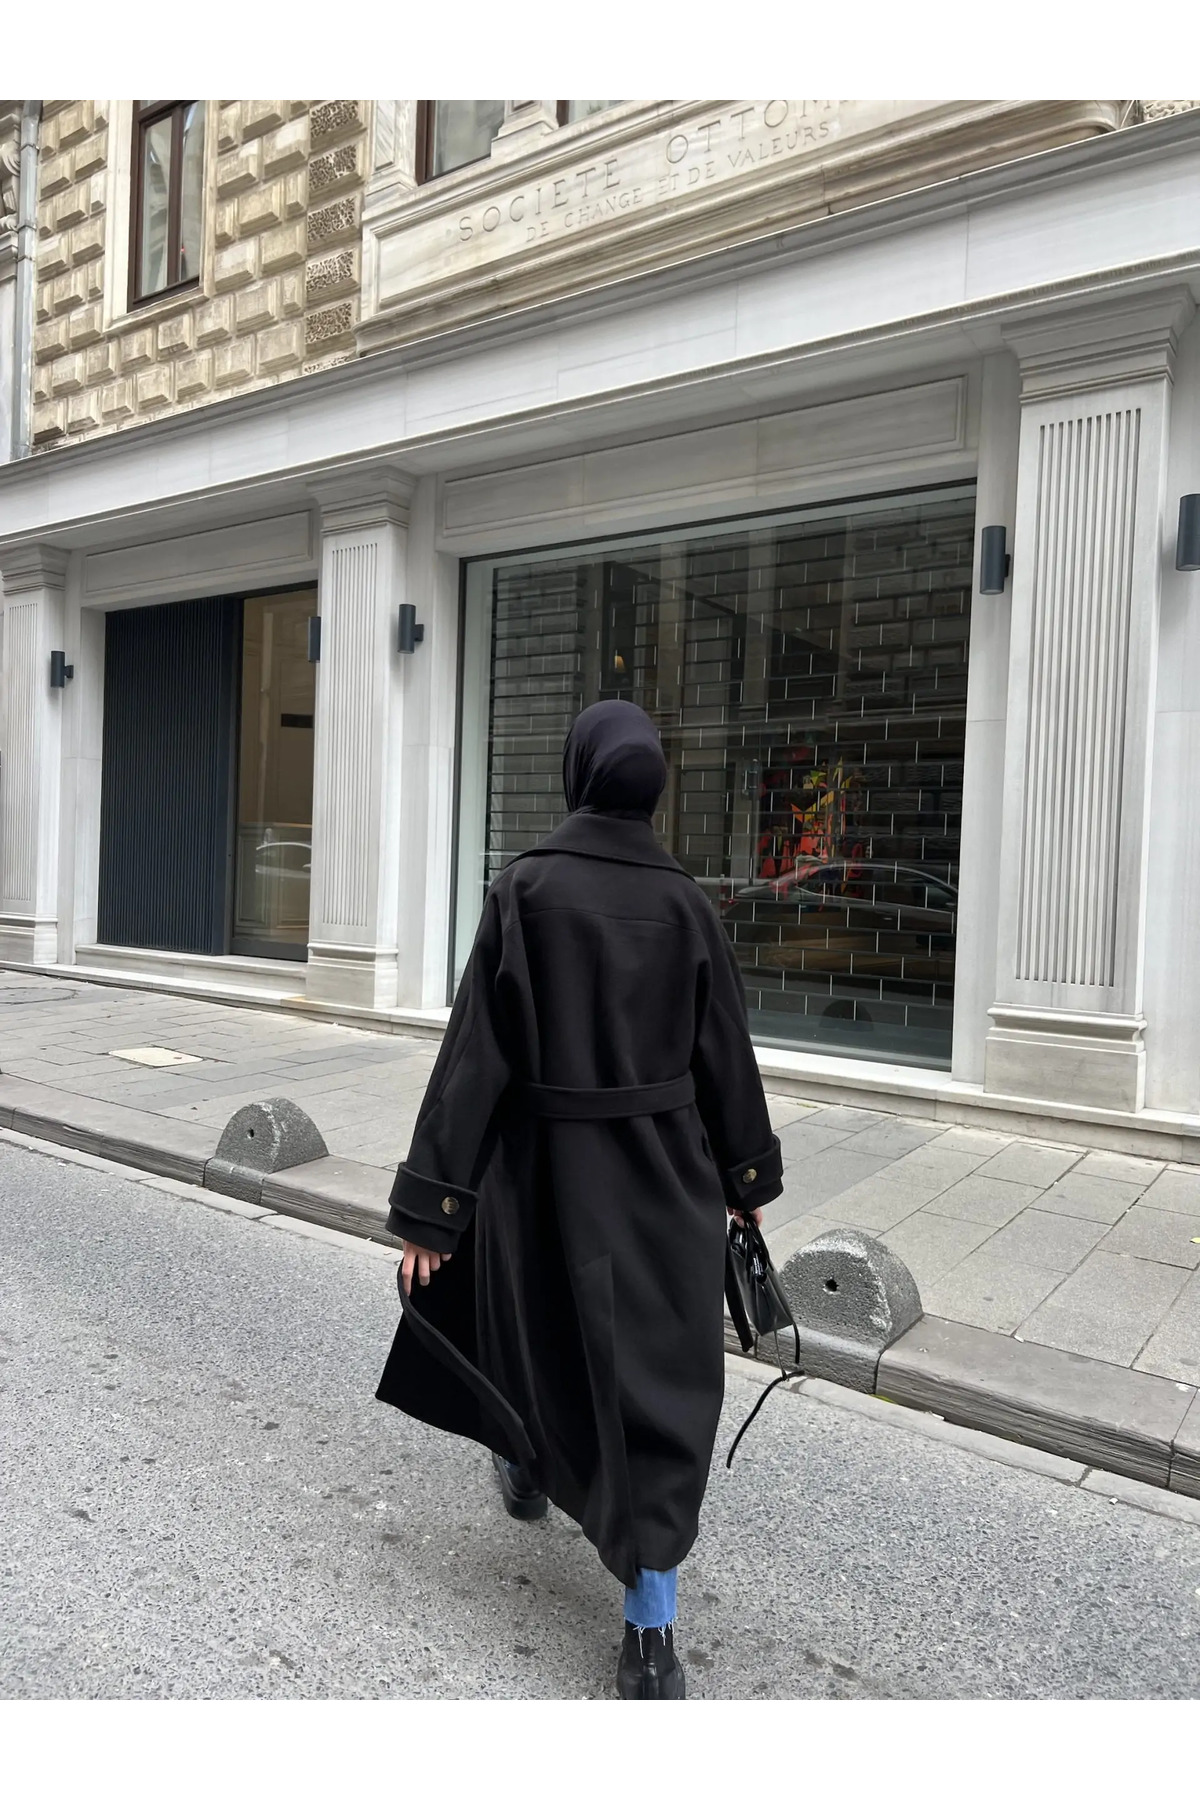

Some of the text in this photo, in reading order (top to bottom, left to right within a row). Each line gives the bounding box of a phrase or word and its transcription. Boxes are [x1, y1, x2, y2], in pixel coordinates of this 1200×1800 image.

[459, 158, 620, 241] SOCIETE
[526, 121, 830, 243] DE CHANGE ET DE VALEURS
